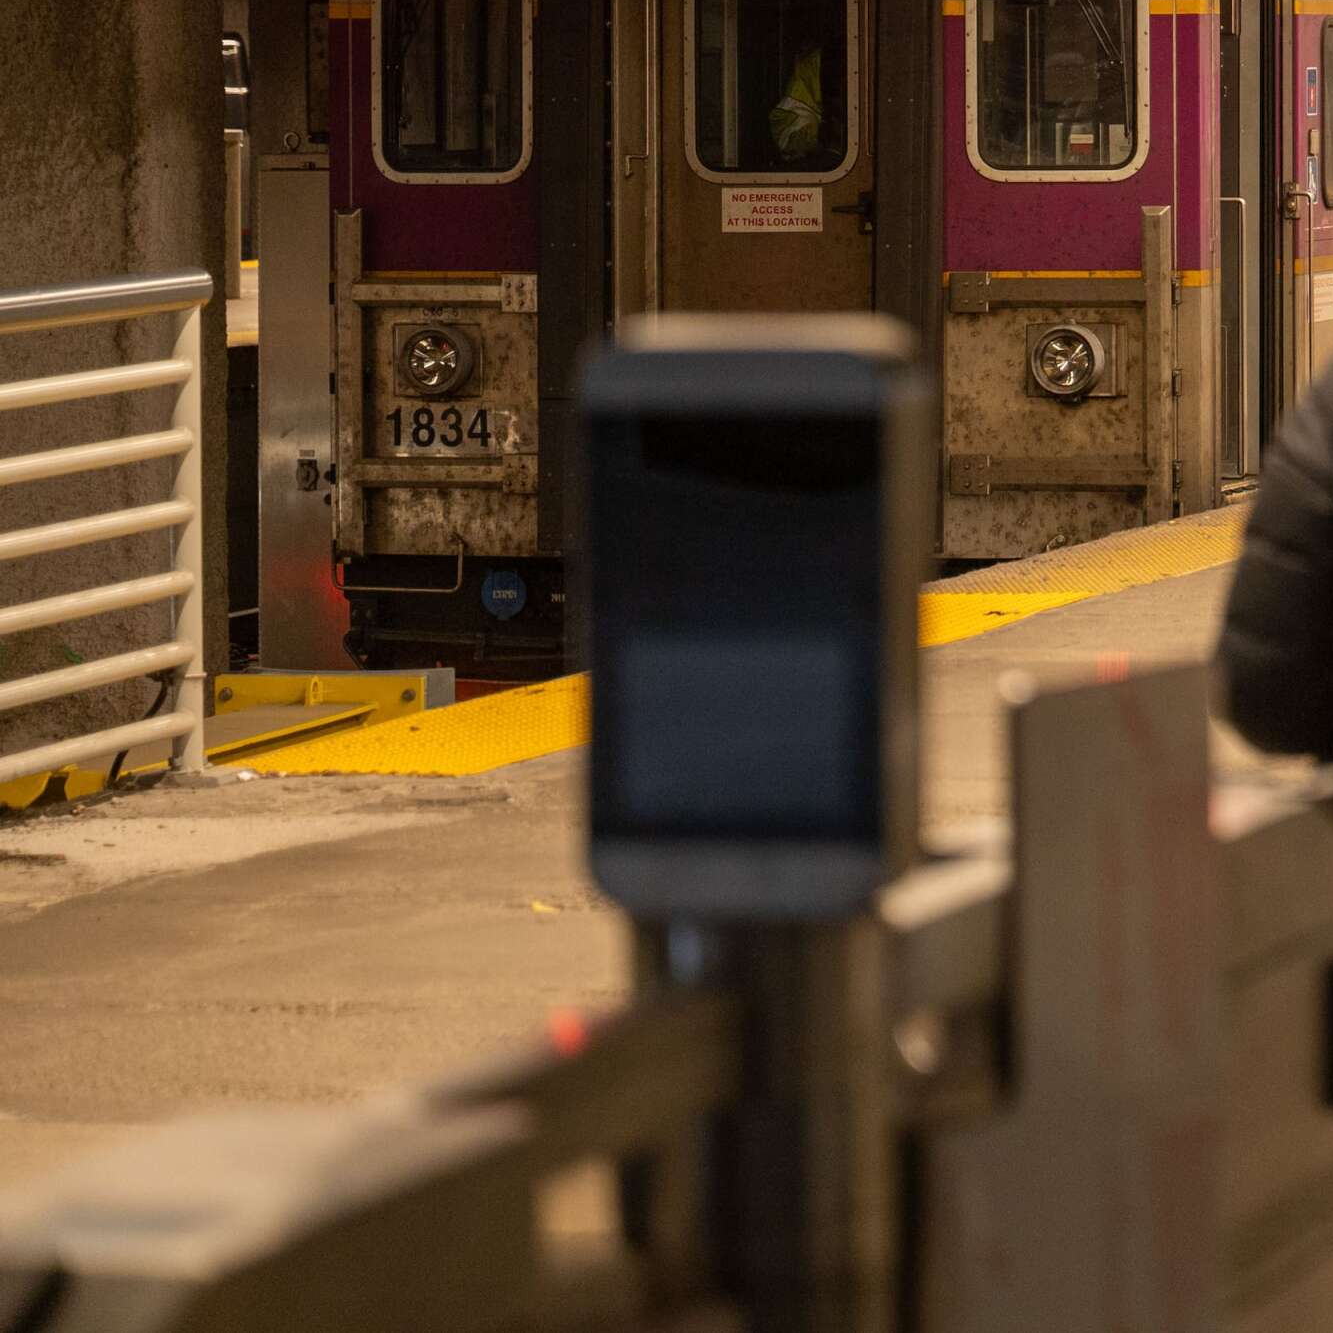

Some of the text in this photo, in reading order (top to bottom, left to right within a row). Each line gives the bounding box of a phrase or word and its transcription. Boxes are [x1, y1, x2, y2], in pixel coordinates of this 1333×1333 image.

[732, 193, 813, 203] NO EMERGENCY
[752, 206, 793, 215] ACCESS
[727, 217, 819, 227] AT THIS LOCATION
